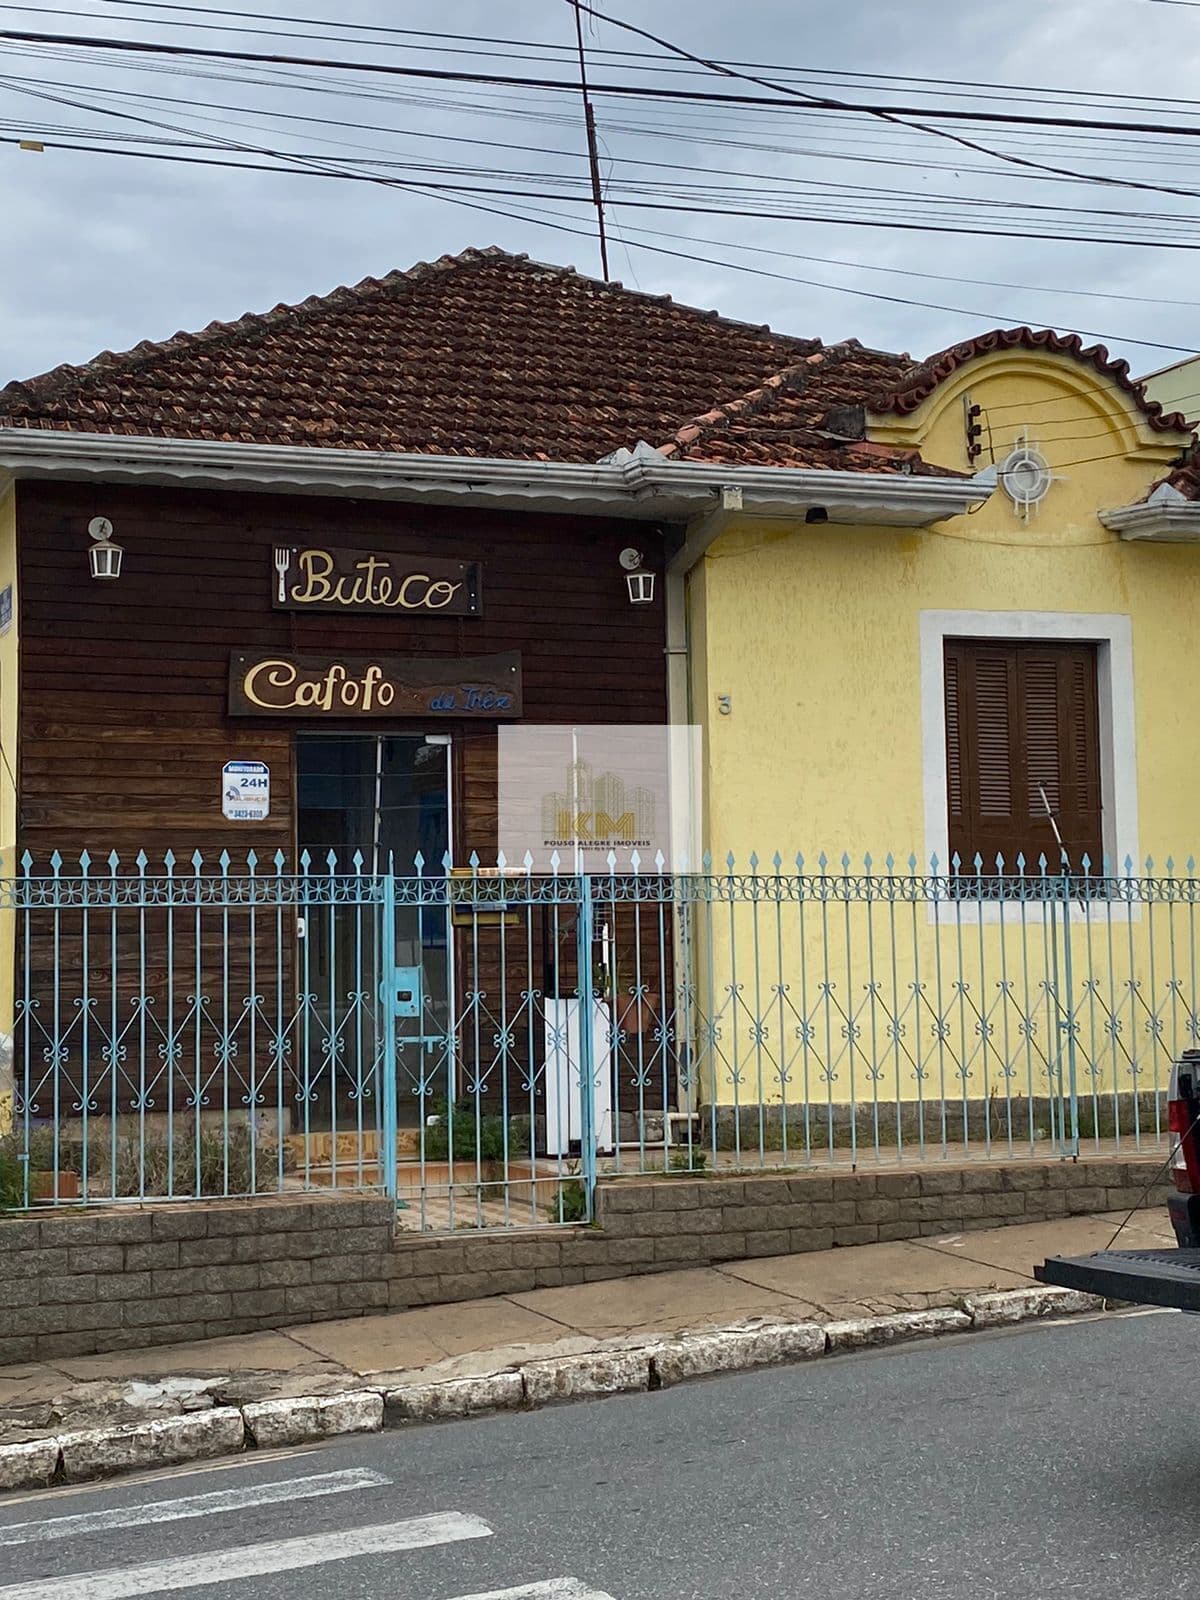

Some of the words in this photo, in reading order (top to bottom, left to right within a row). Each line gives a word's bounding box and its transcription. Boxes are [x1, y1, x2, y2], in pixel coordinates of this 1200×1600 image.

[291, 550, 462, 608] Buteco
[244, 660, 394, 711] Cafofo
[717, 695, 732, 715] 3
[240, 778, 268, 787] 24H
